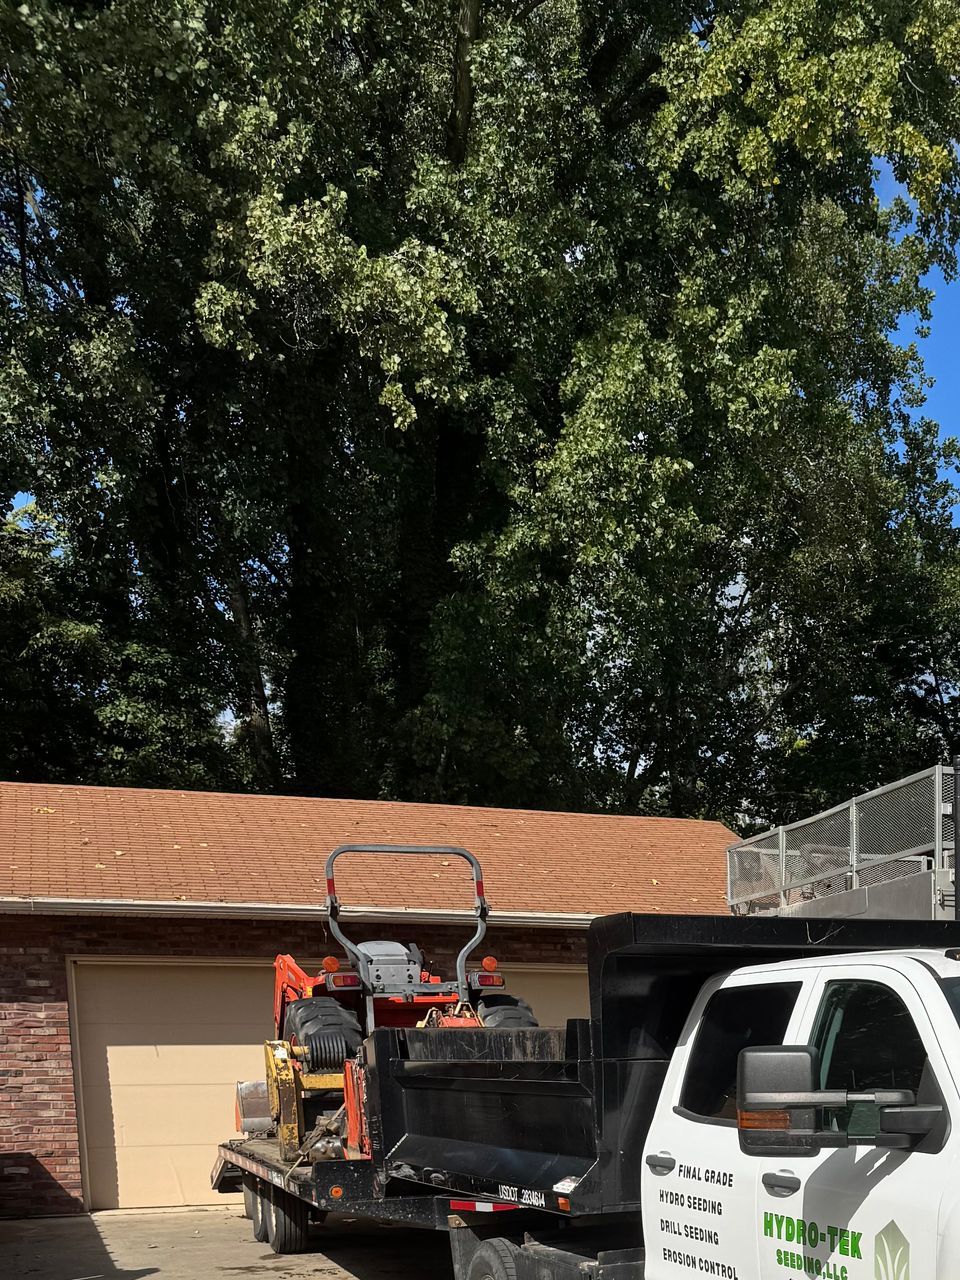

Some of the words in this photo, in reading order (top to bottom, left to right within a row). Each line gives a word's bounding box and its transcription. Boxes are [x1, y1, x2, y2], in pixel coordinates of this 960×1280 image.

[678, 1164, 702, 1181] FINAL
[704, 1169, 734, 1188] GRADE
[498, 1184, 518, 1201] USDOT
[659, 1189, 685, 1207] HYDRO
[687, 1195, 722, 1215] SEEDING
[660, 1218, 682, 1236] DRILL
[684, 1224, 719, 1245] SEEDING
[763, 1211, 862, 1259] HYDRO-TEK
[662, 1247, 697, 1269] EROSION
[699, 1257, 739, 1280] CONTROL
